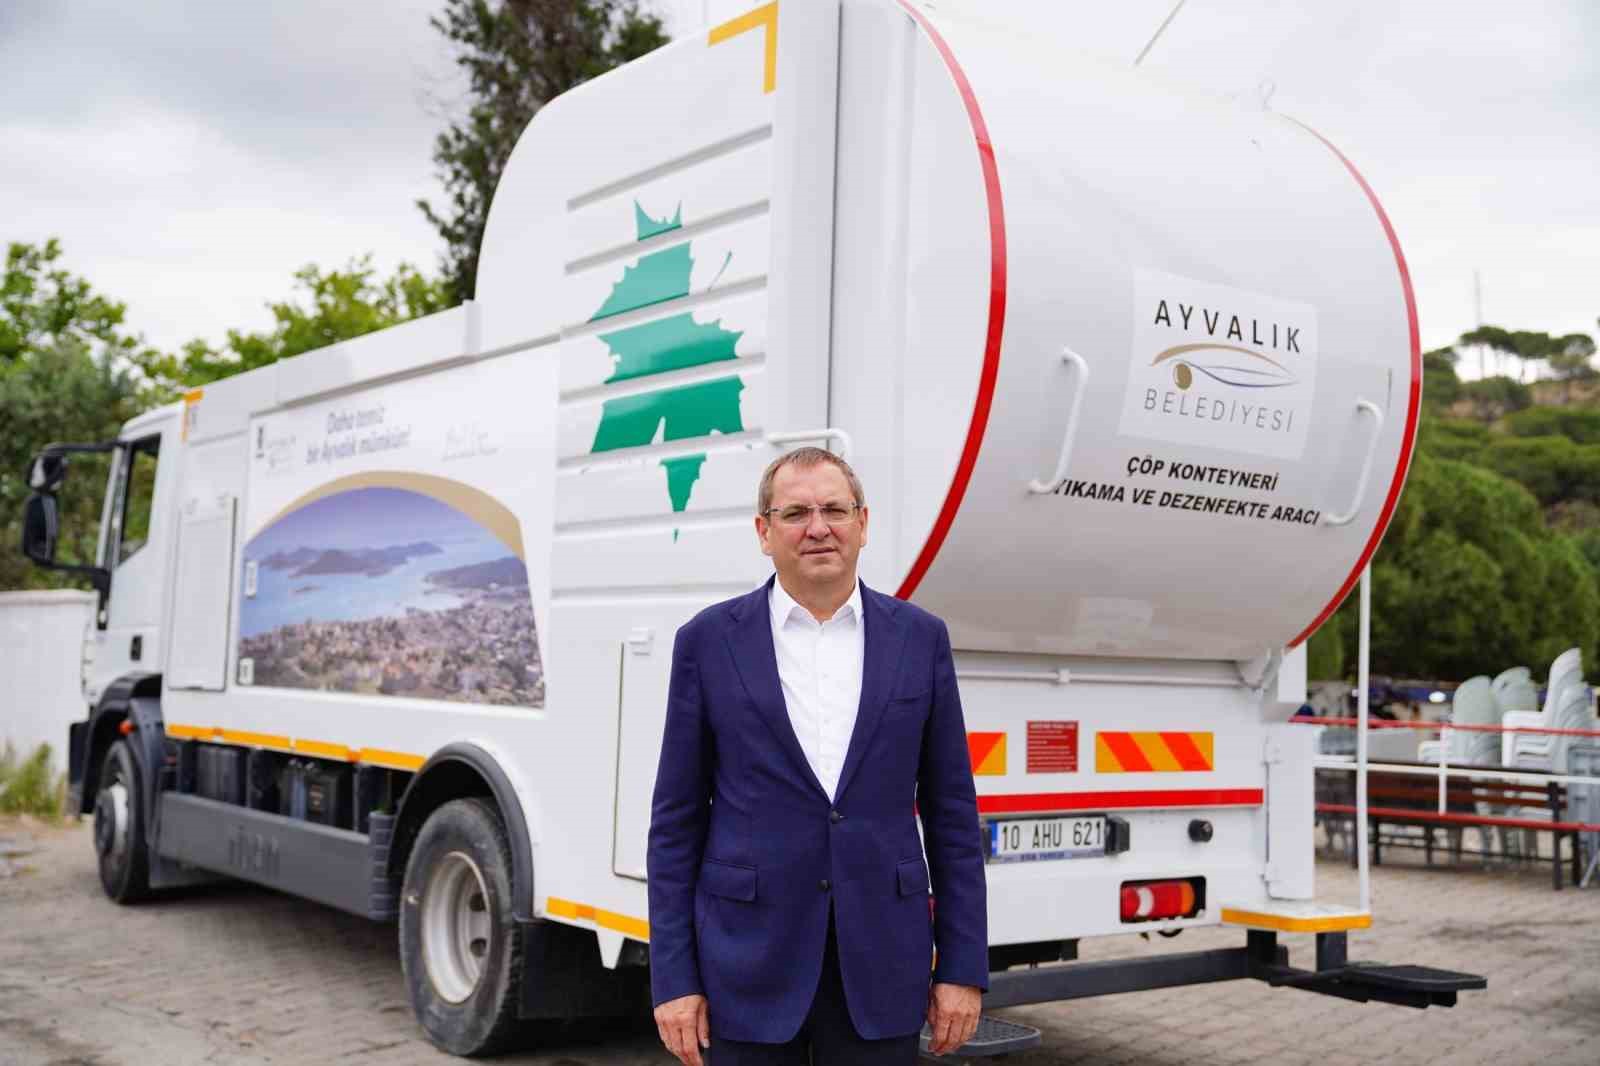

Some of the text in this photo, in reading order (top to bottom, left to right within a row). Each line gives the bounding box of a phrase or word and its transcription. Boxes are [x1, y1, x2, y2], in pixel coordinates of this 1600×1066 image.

[1154, 299, 1301, 353] AYVALIK
[1144, 388, 1293, 433] BELEDİYESİ
[1127, 455, 1280, 491] ÇÖP KONTEYNERİ
[1132, 488, 1156, 506] VE
[1159, 492, 1269, 519] DEZENFEKTE
[1271, 504, 1320, 526] ARACI
[1003, 825, 1021, 851] 10
[1032, 823, 1063, 849] AHU
[1073, 820, 1102, 847] 621
